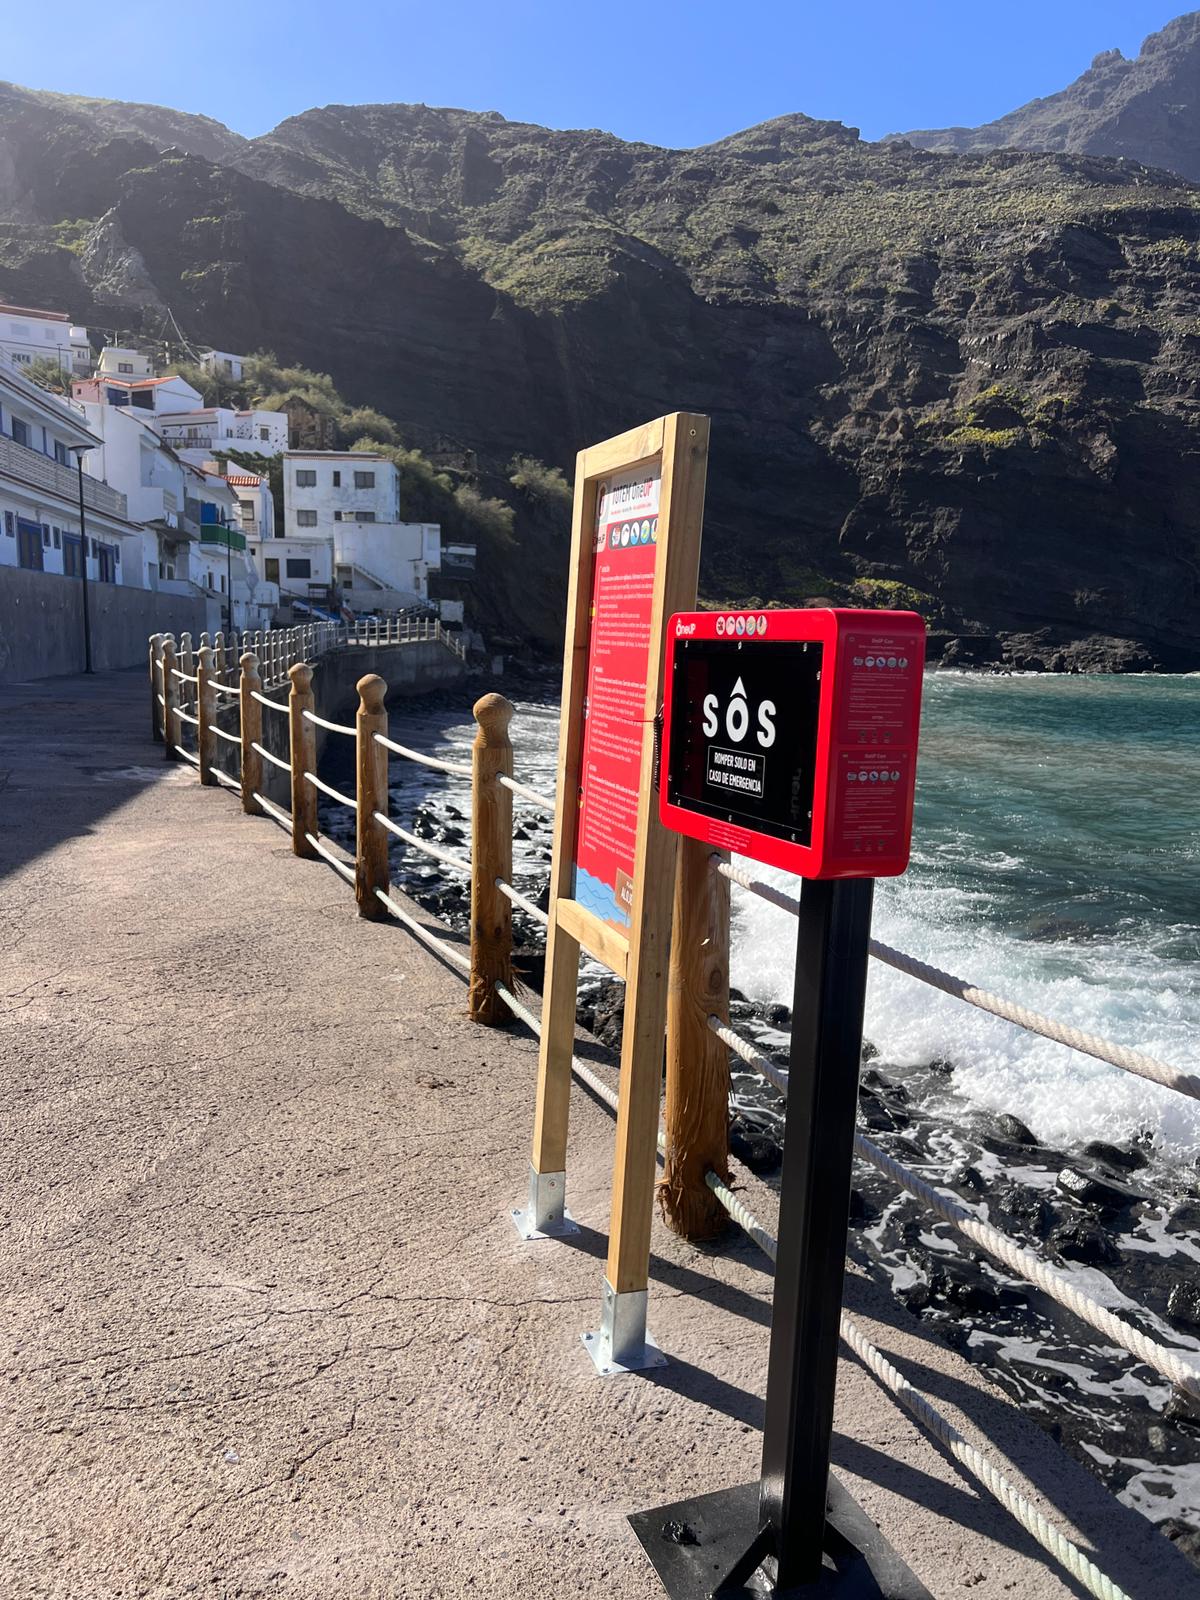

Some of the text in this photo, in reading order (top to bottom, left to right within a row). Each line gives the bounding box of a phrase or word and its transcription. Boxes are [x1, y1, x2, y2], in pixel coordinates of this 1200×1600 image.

[714, 752, 756, 772] ROMPER SOLO EN
[709, 769, 762, 793] CASO DE EMERGENCIA
